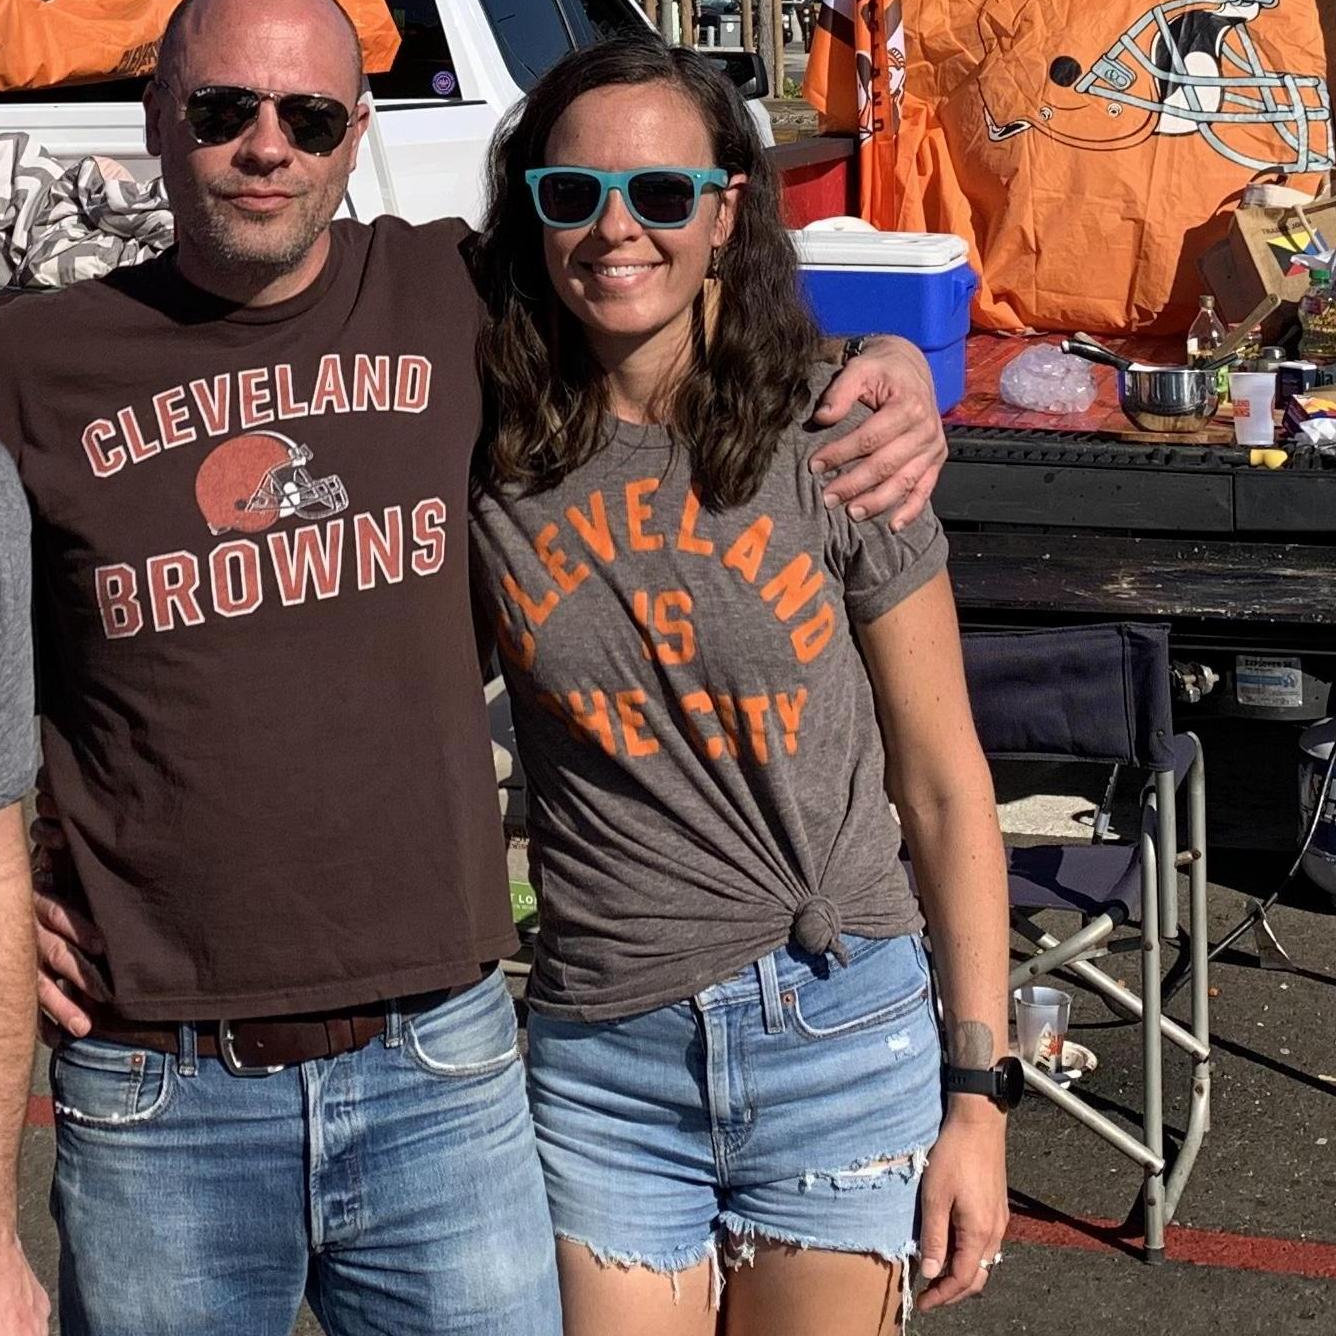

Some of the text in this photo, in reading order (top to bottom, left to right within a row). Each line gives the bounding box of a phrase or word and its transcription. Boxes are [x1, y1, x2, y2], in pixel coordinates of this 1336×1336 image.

[81, 354, 432, 478] CLEVELAND
[95, 497, 446, 639] BROWNS
[632, 589, 696, 665] IS
